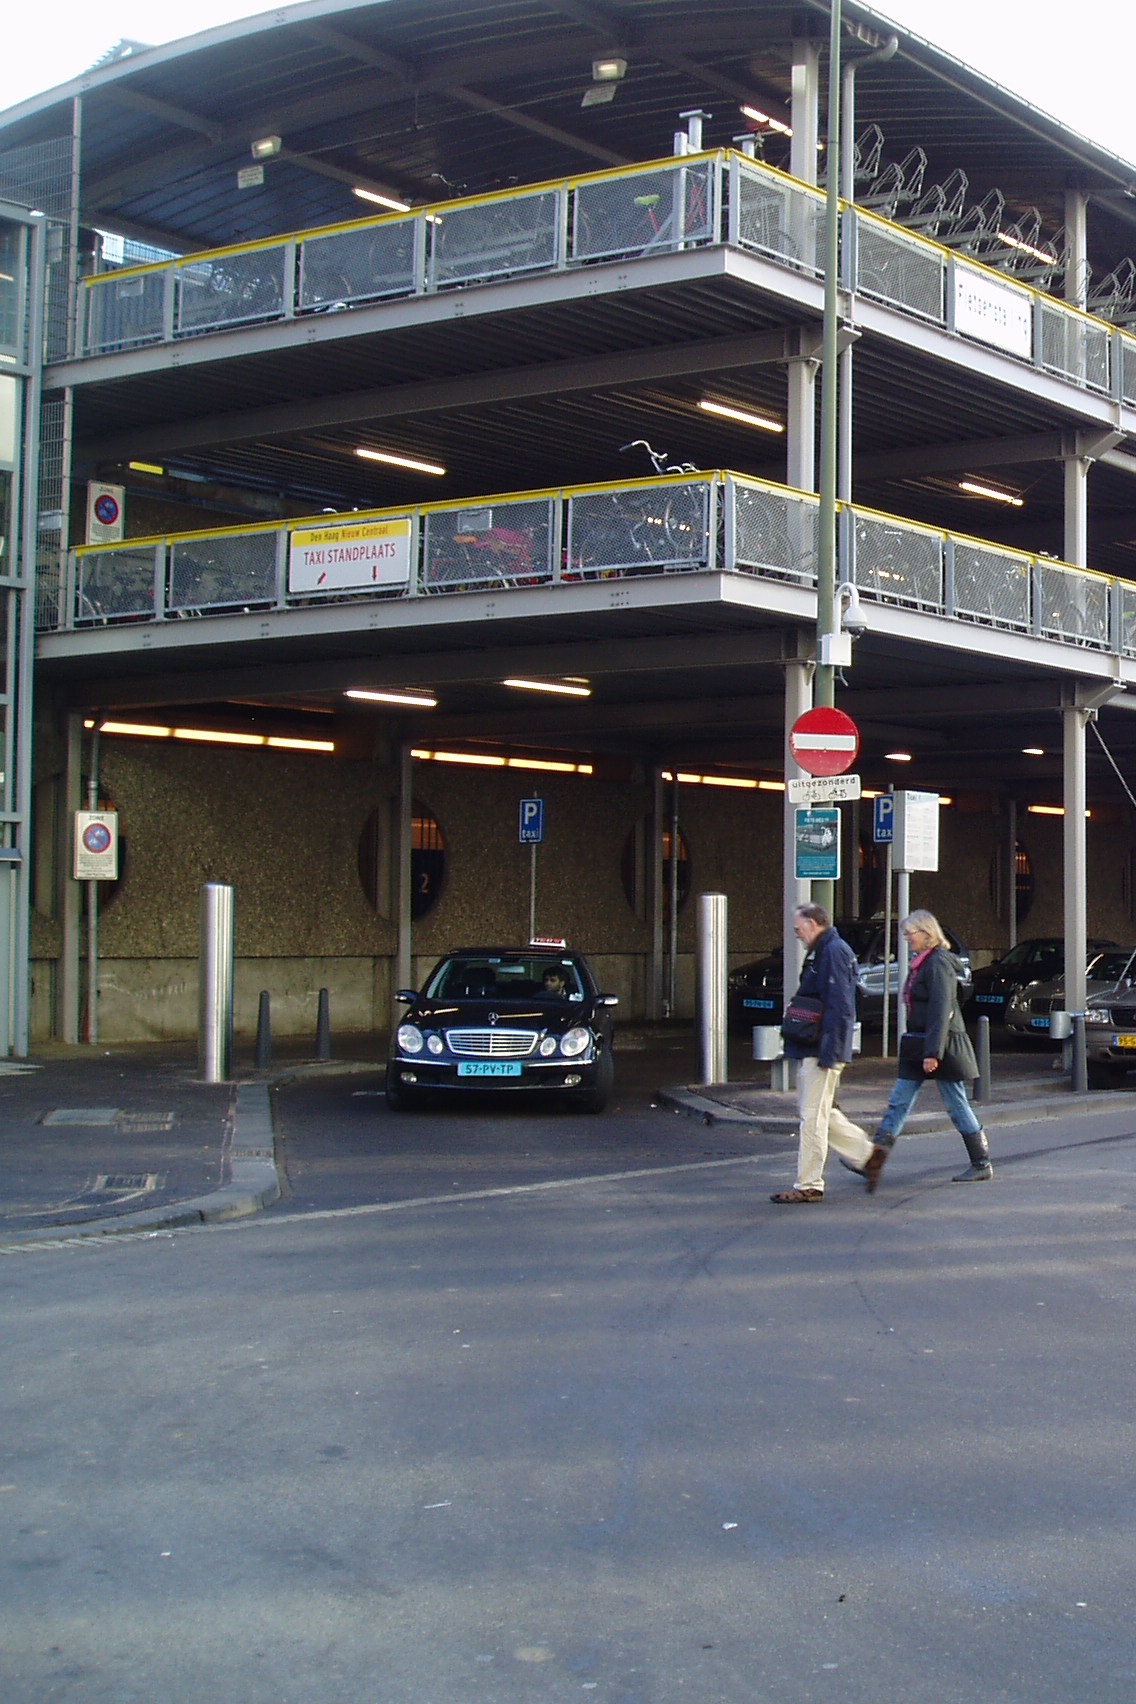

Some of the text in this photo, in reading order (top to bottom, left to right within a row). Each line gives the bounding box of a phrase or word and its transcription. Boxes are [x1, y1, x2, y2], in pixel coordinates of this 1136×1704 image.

[310, 525, 389, 542] Den Haag Nieuw Centraal
[304, 543, 396, 566] TAXI STANDPLAATS
[791, 777, 857, 790] uitgezonderd
[524, 803, 537, 825] P
[879, 798, 893, 823] P
[522, 828, 538, 839] taxi
[876, 828, 893, 838] tax
[466, 1063, 514, 1074] 57-PV-TP
